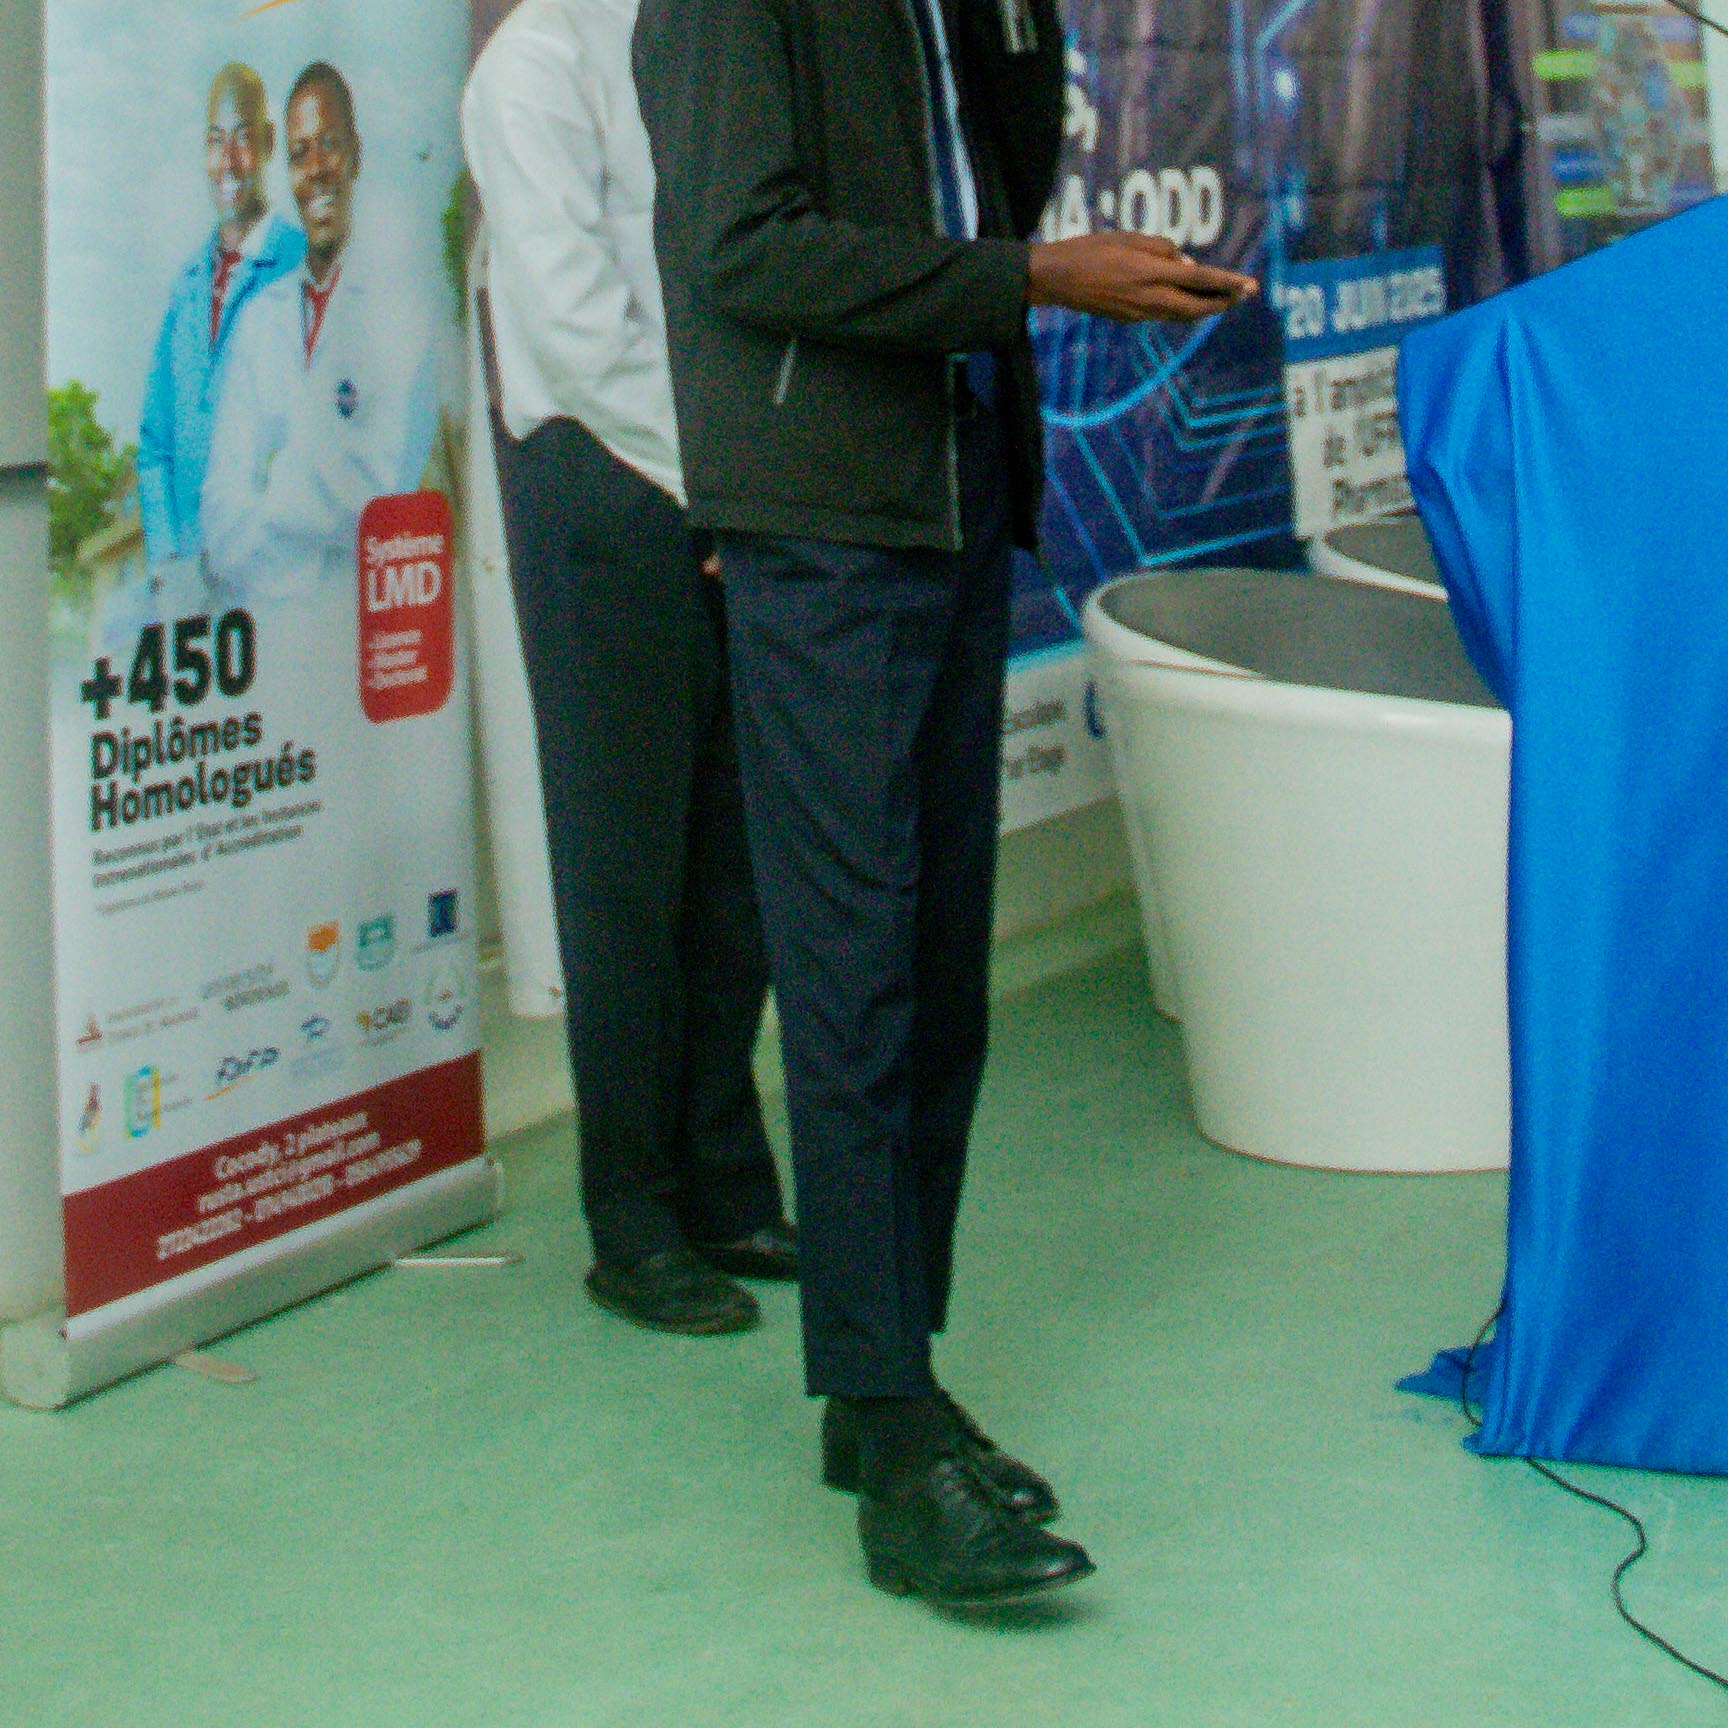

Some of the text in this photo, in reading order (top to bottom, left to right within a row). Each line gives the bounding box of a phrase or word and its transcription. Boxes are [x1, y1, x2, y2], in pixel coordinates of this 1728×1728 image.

[1288, 284, 1323, 338] 20
[1331, 274, 1385, 329] JUIN
[367, 531, 444, 567] Système
[368, 561, 443, 612] LMD
[80, 608, 257, 721] +450
[91, 711, 263, 783] Diplômes
[90, 739, 319, 832] Homologués
